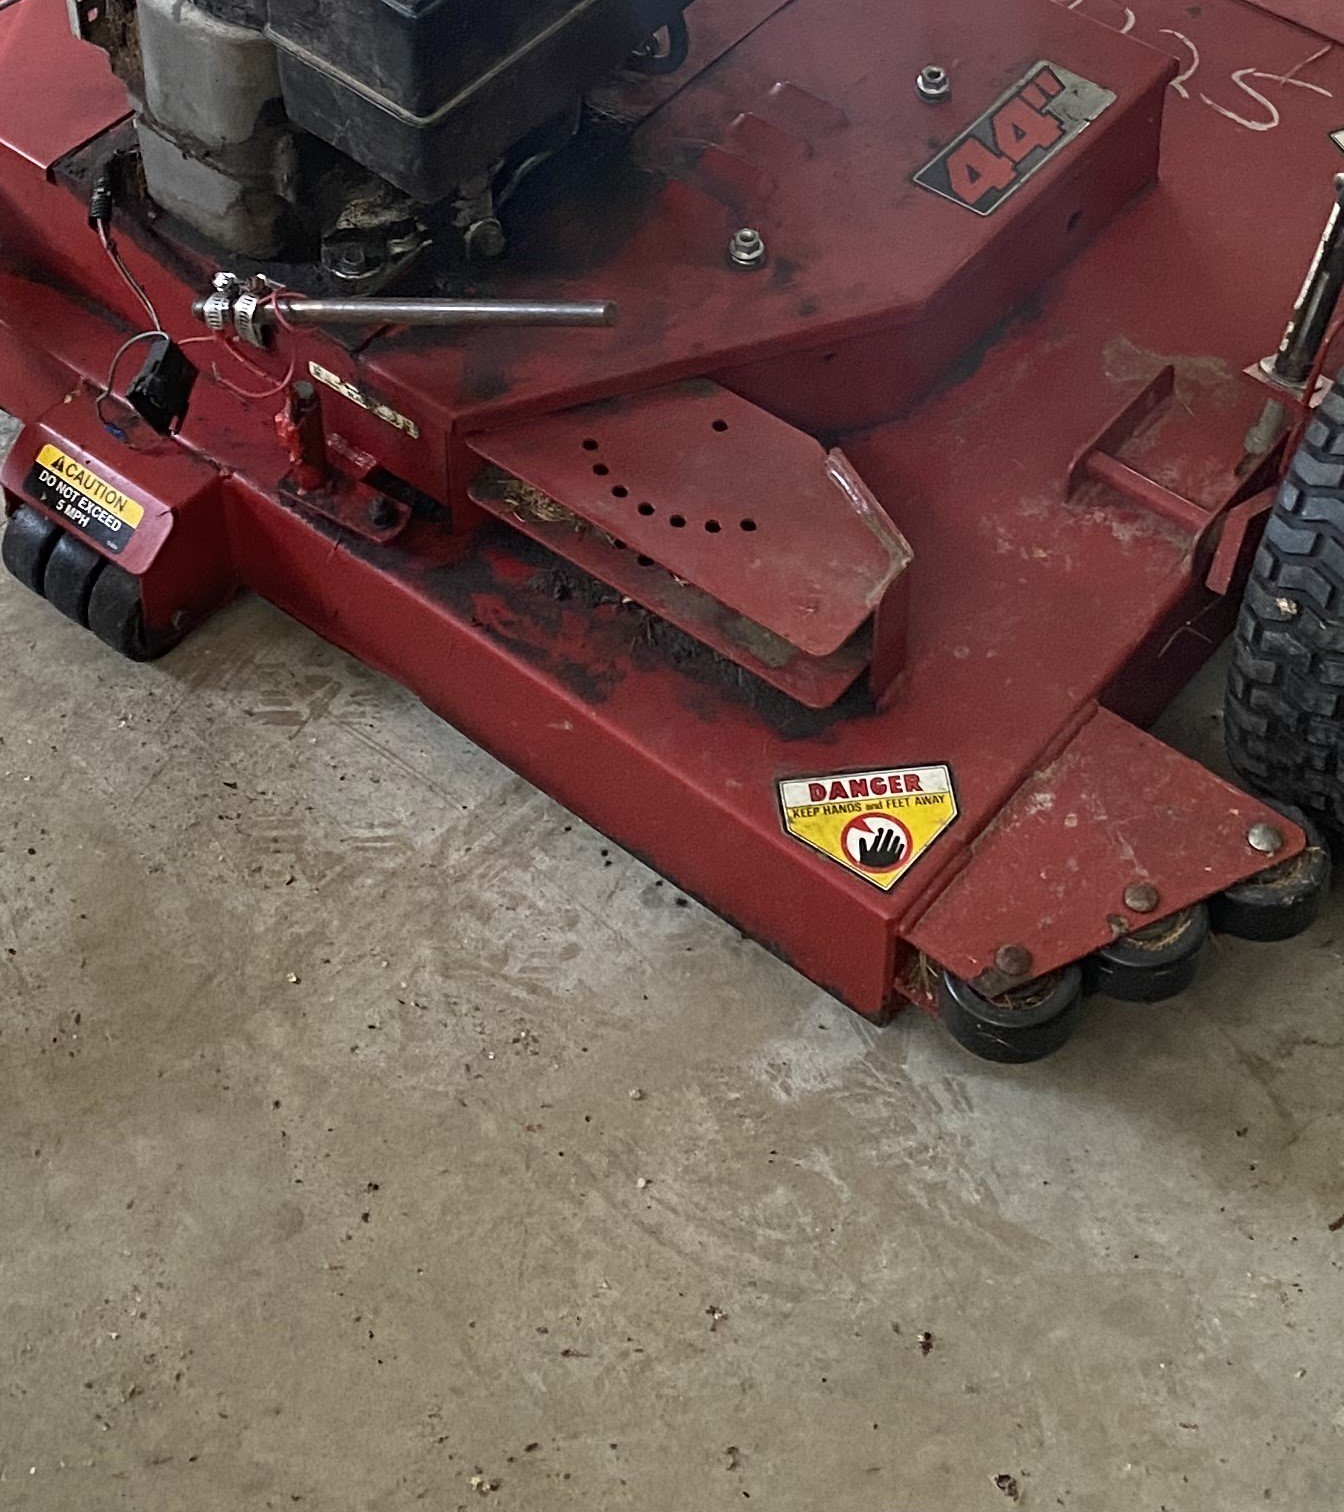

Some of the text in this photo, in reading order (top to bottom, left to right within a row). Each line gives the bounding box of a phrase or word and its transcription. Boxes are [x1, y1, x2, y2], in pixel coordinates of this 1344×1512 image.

[39, 470, 122, 532] DO NOT EXCEED
[65, 464, 128, 512] CAUTION
[56, 499, 90, 528] 5 MPH
[808, 773, 924, 803] DANGER
[792, 794, 945, 819] KEEP HANDS and FEET AWAY
